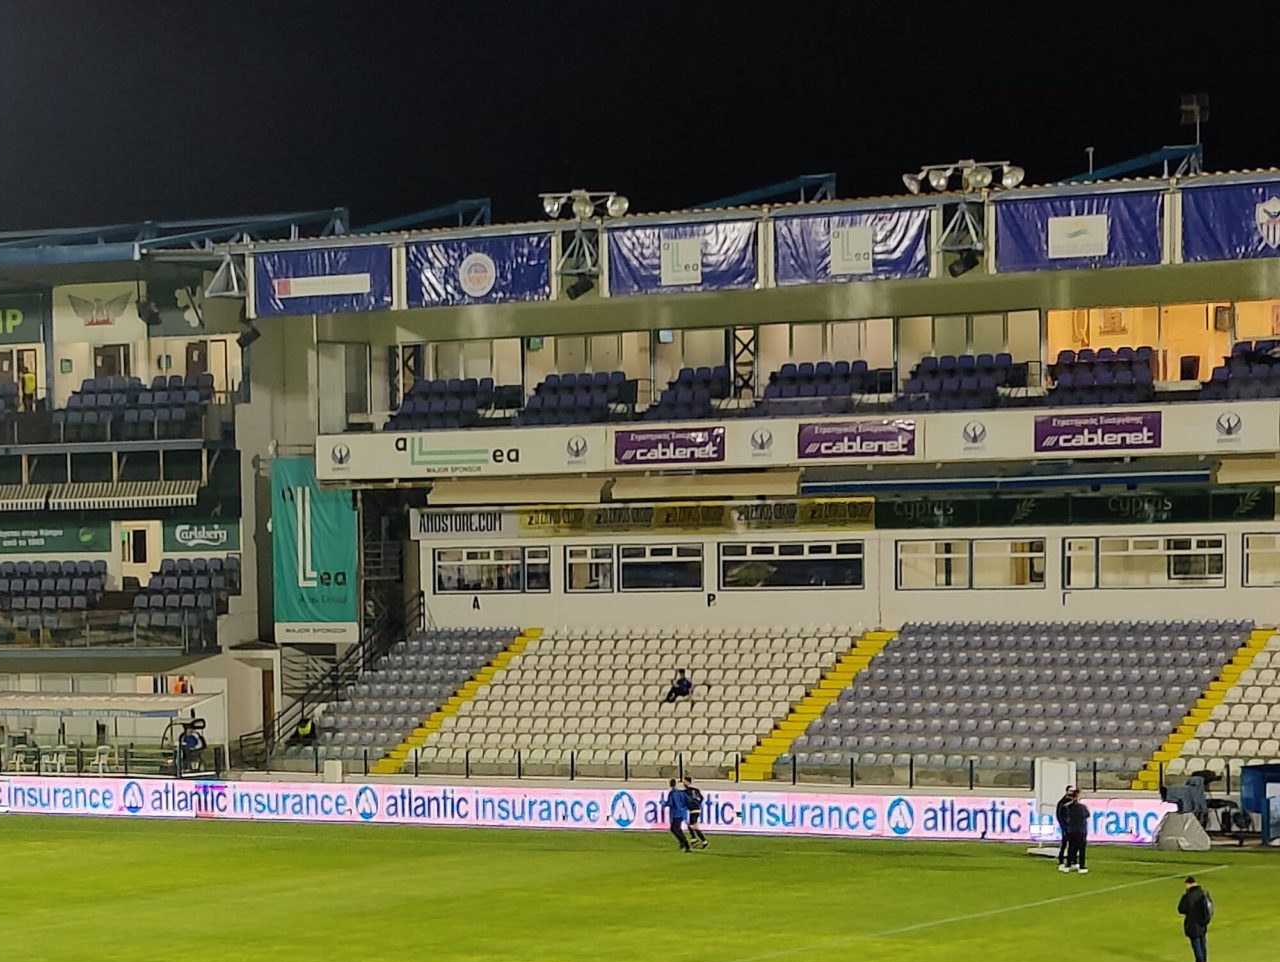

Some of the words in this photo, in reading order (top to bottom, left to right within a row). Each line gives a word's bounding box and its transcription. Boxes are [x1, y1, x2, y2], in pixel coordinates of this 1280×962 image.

[821, 436, 908, 454] cablenet
[1059, 427, 1154, 447] cablenet
[636, 441, 718, 460] cablenet
[175, 523, 227, 546] Carlsberg
[7, 780, 114, 810] insurance
[151, 783, 227, 812] atlantic
[233, 784, 347, 816] insurance
[386, 788, 469, 820] atlantic
[475, 792, 600, 823] insurance
[644, 792, 735, 825] attic
[741, 797, 877, 831] insurance
[923, 799, 1021, 833] atlantic
